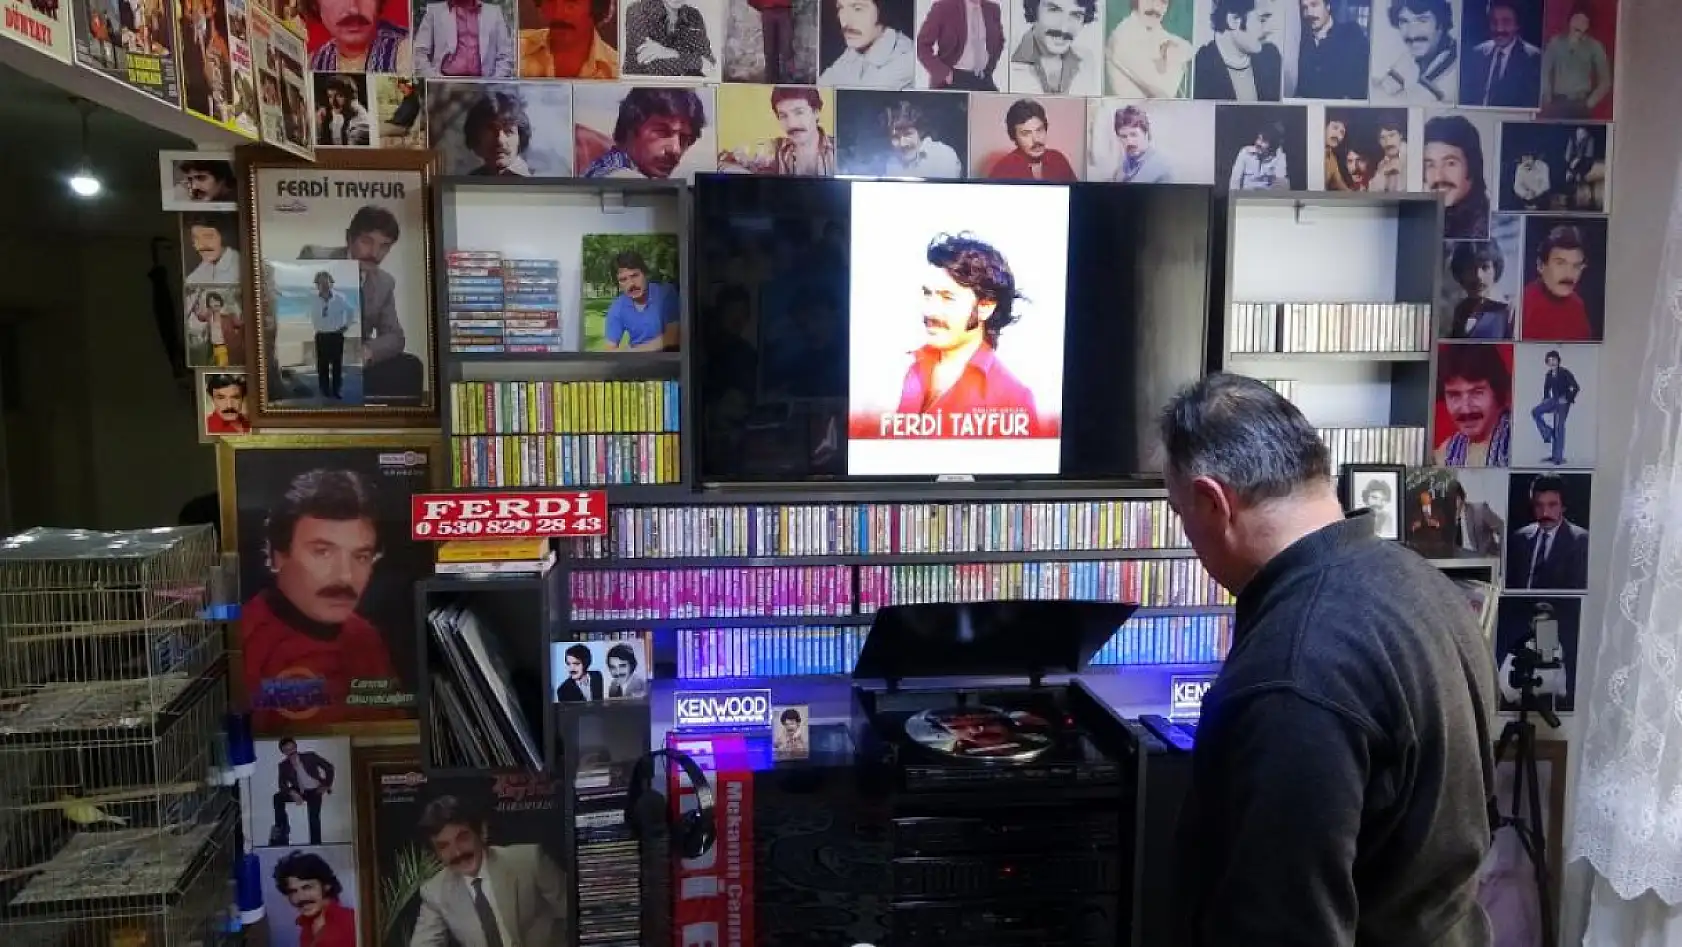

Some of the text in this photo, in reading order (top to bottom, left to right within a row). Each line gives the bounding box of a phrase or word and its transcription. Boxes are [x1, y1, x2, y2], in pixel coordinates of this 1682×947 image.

[277, 177, 405, 199] FERDİ TAYFUR
[880, 408, 1030, 436] FERDİ TAYFUR
[423, 493, 592, 520] FERDİ
[415, 517, 601, 535] 0 530 829 28 43
[677, 696, 766, 717] KENWOOD
